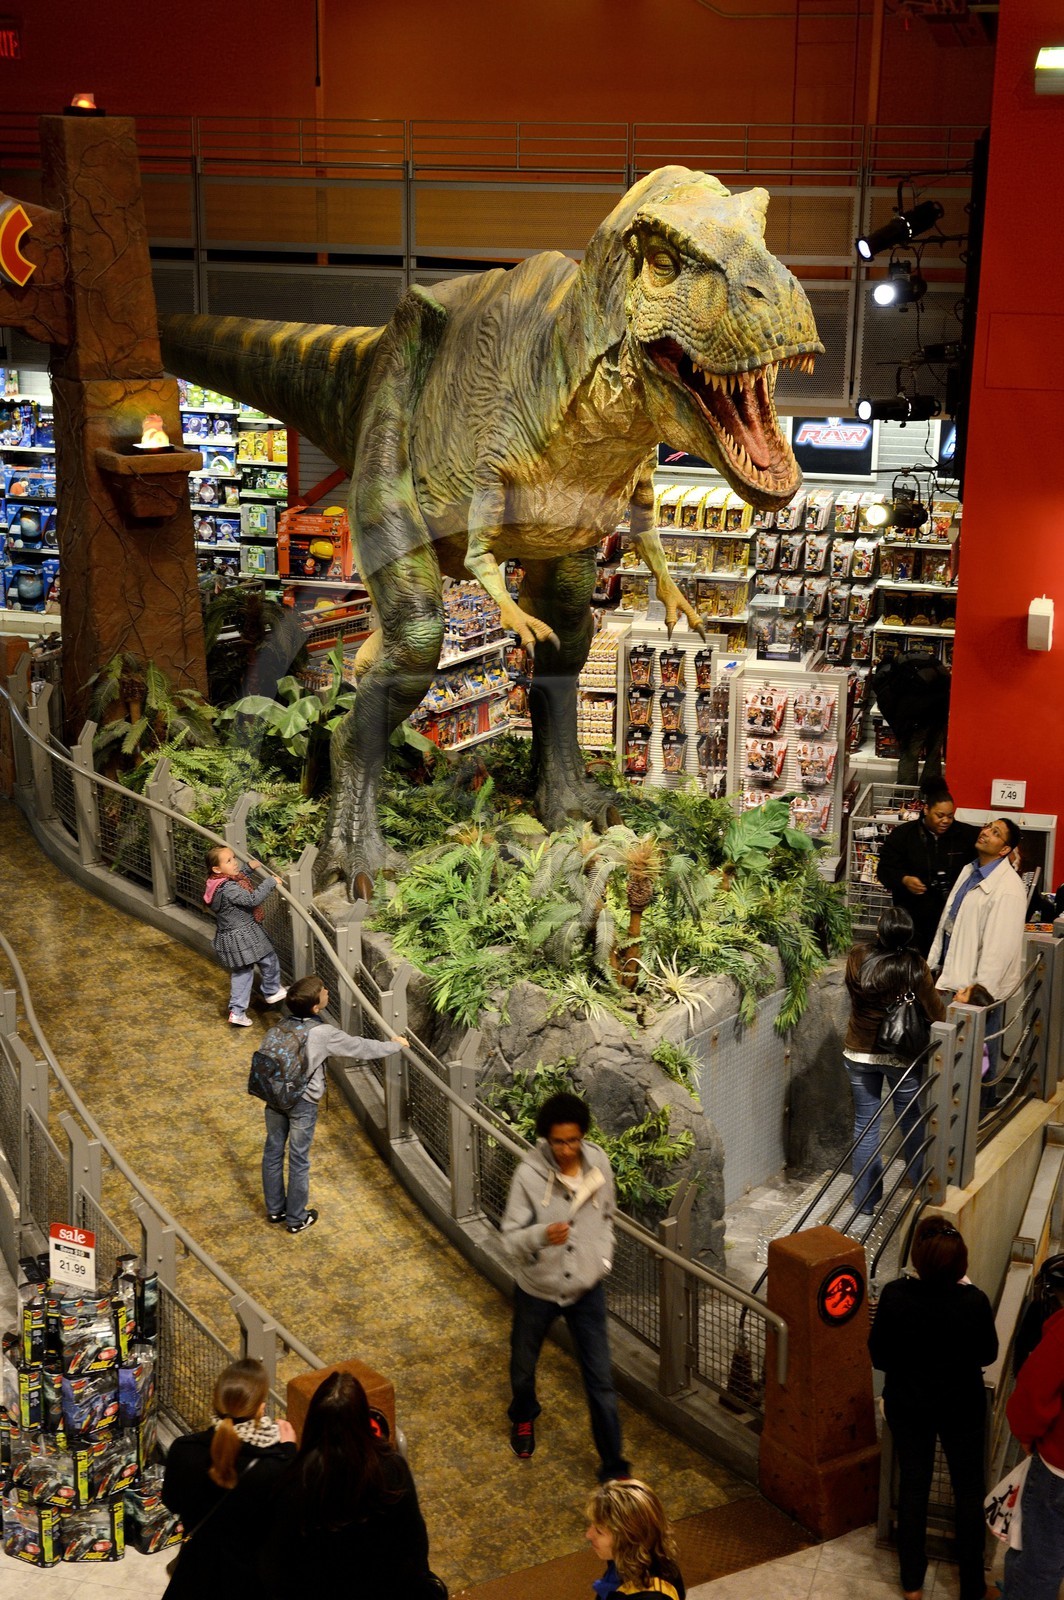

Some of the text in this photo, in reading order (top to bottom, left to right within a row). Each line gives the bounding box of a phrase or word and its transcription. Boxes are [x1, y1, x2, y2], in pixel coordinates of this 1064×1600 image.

[797, 426, 869, 445] RAW
[1000, 790, 1017, 800] 7.49
[58, 1228, 86, 1244] sale
[59, 1259, 86, 1275] 21.99
